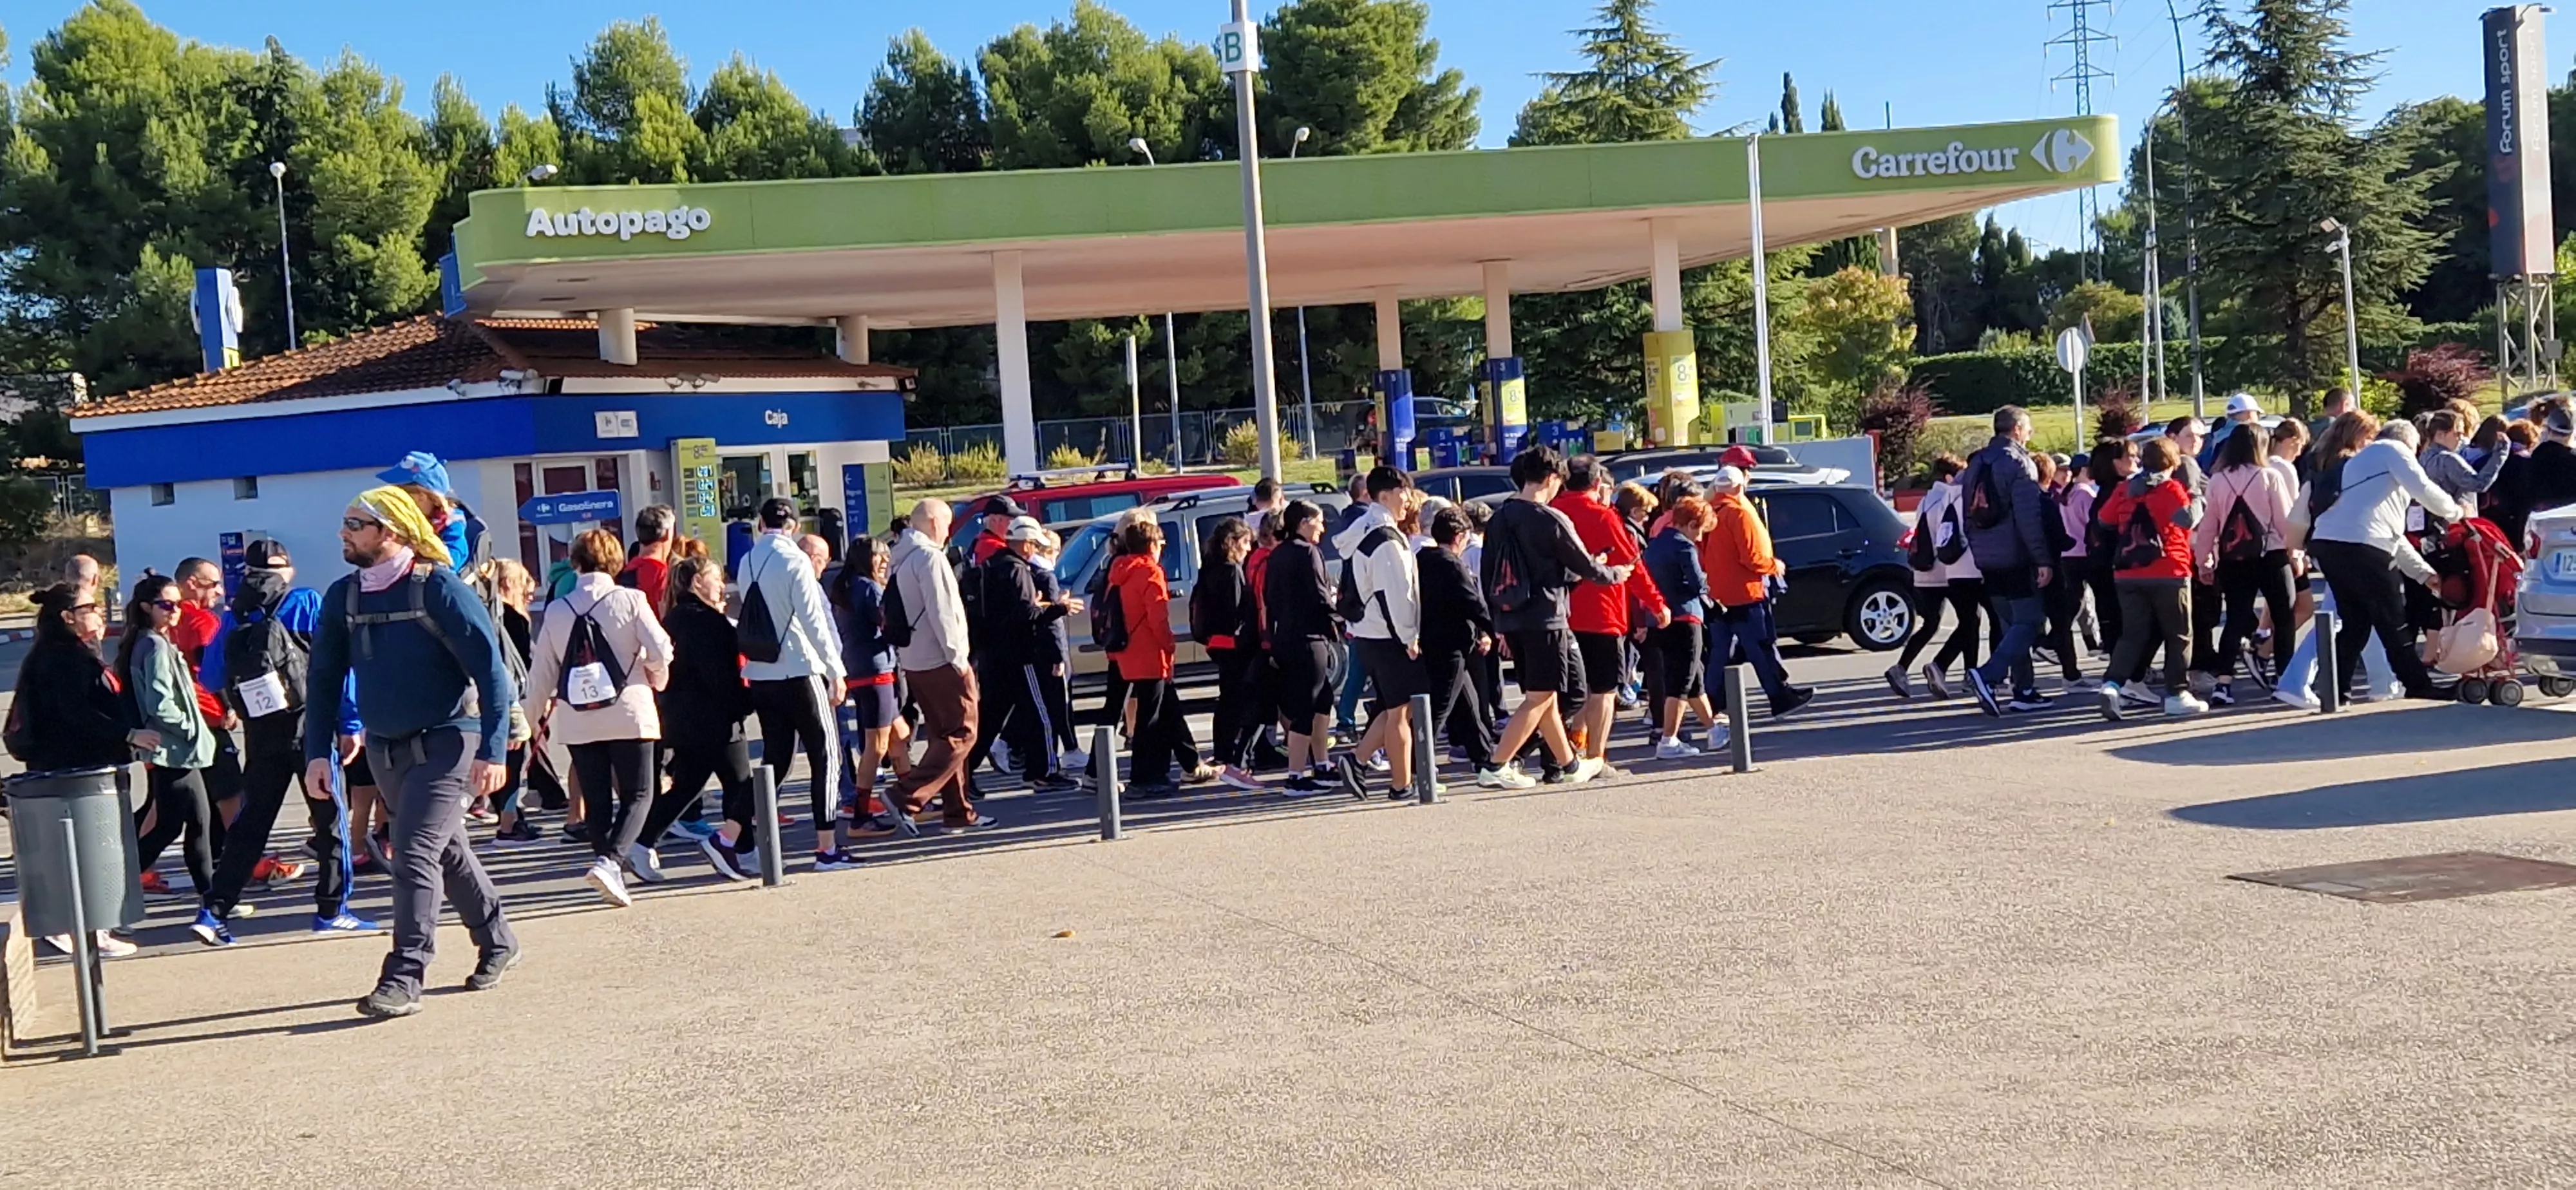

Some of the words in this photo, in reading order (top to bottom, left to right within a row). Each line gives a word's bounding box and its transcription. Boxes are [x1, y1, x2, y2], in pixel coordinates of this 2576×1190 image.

[1224, 32, 1242, 63] B
[2497, 29, 2511, 84] sport
[1852, 140, 2020, 179] Carrefour
[525, 206, 712, 241] Autopago
[1678, 364, 1687, 381] 8
[765, 408, 788, 429] Caja
[1551, 426, 1558, 436] 3
[558, 500, 614, 513] Gasolinera
[582, 685, 599, 700] 13
[254, 696, 274, 712] 12
